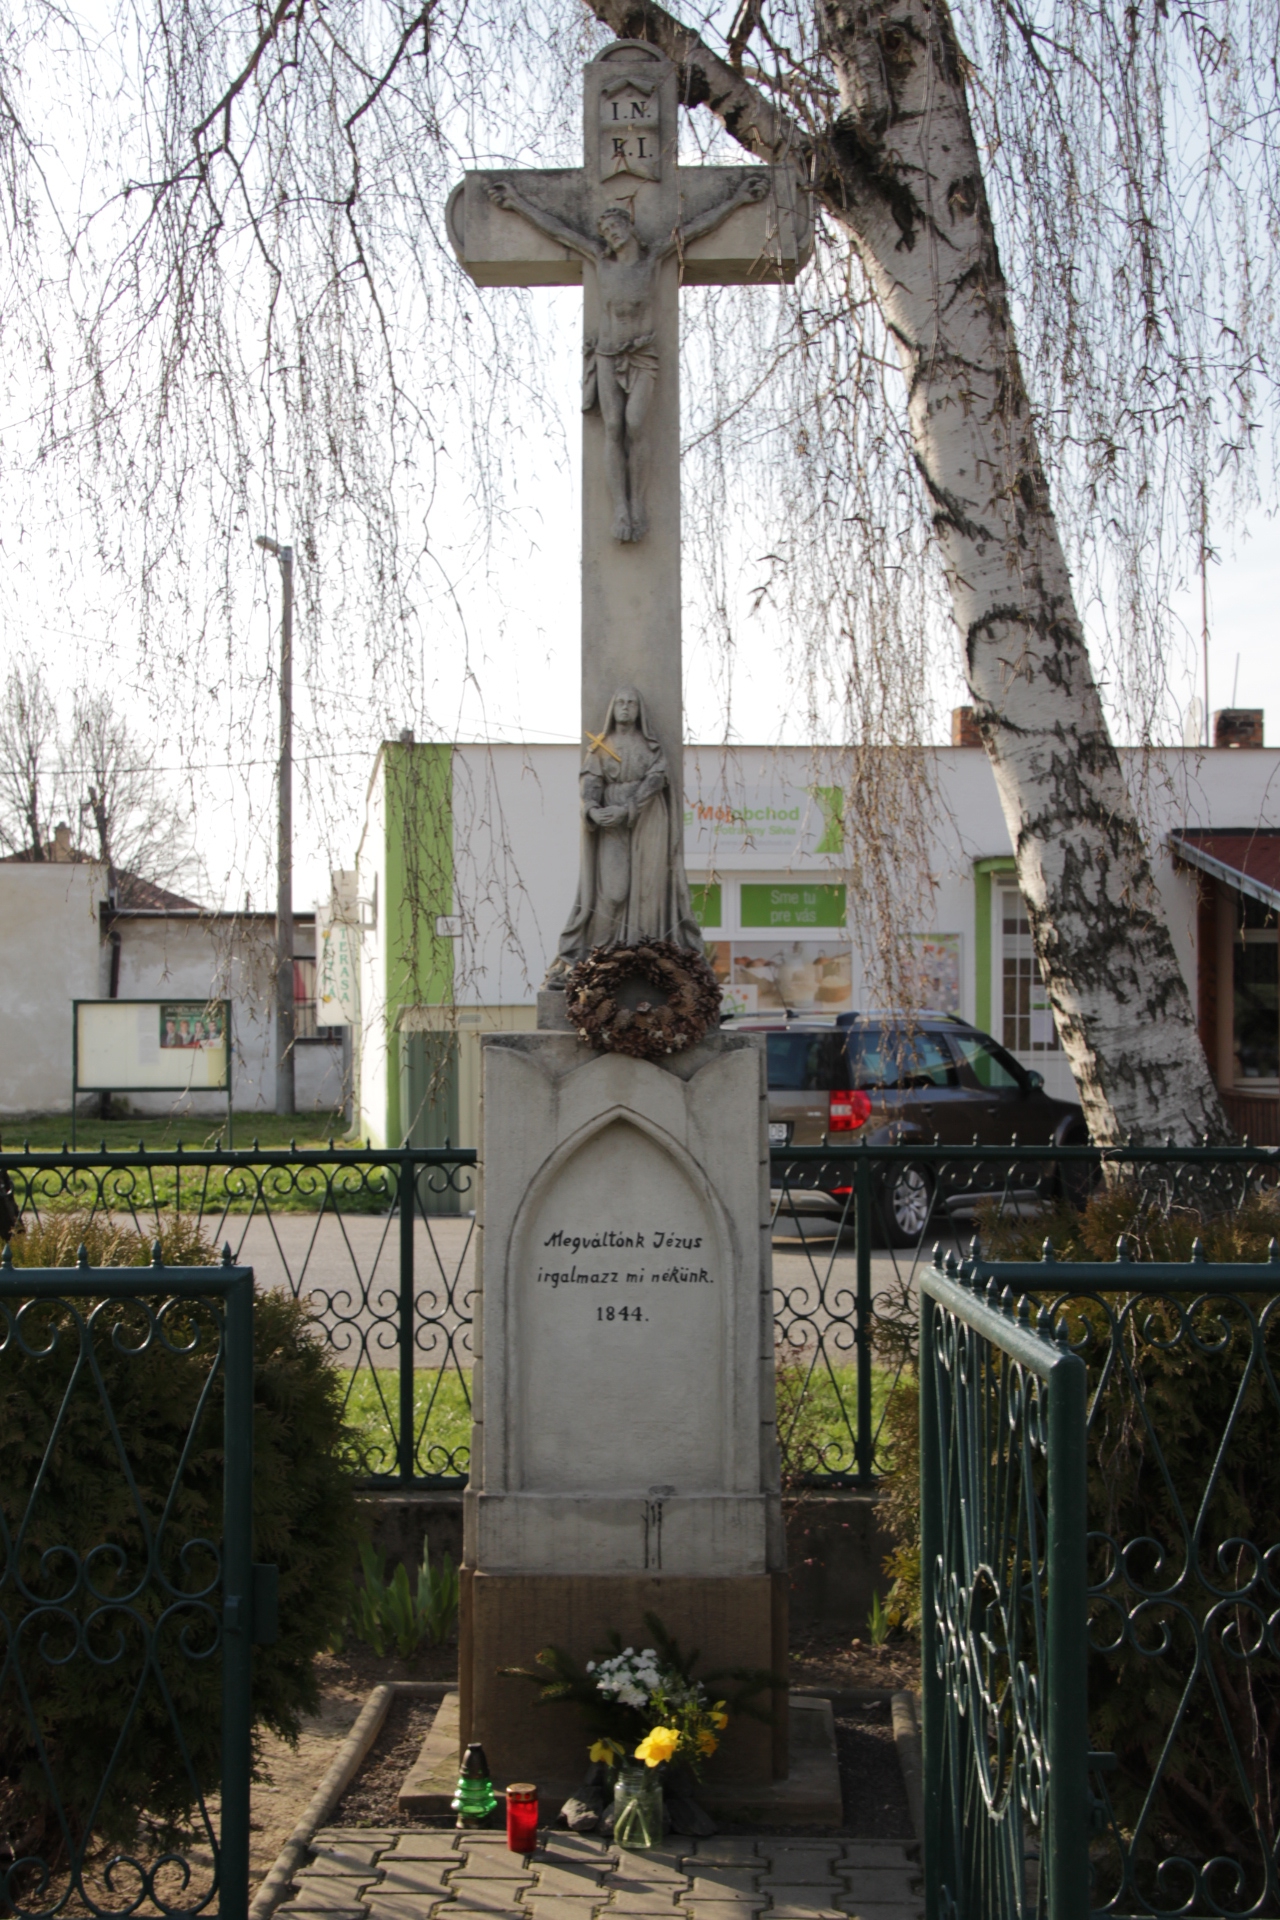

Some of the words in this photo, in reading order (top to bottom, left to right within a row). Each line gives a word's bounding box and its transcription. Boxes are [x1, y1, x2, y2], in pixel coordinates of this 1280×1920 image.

[770, 890, 799, 904] Sme
[803, 891, 816, 904] tu
[770, 911, 791, 924] pre
[795, 908, 817, 922] vás
[339, 927, 350, 1002] TERASA
[544, 1230, 645, 1254] Megváltónk
[653, 1231, 703, 1249] Jézus
[537, 1265, 619, 1288] irgalmazz
[626, 1268, 645, 1283] mi
[597, 1306, 650, 1322] 1844.
